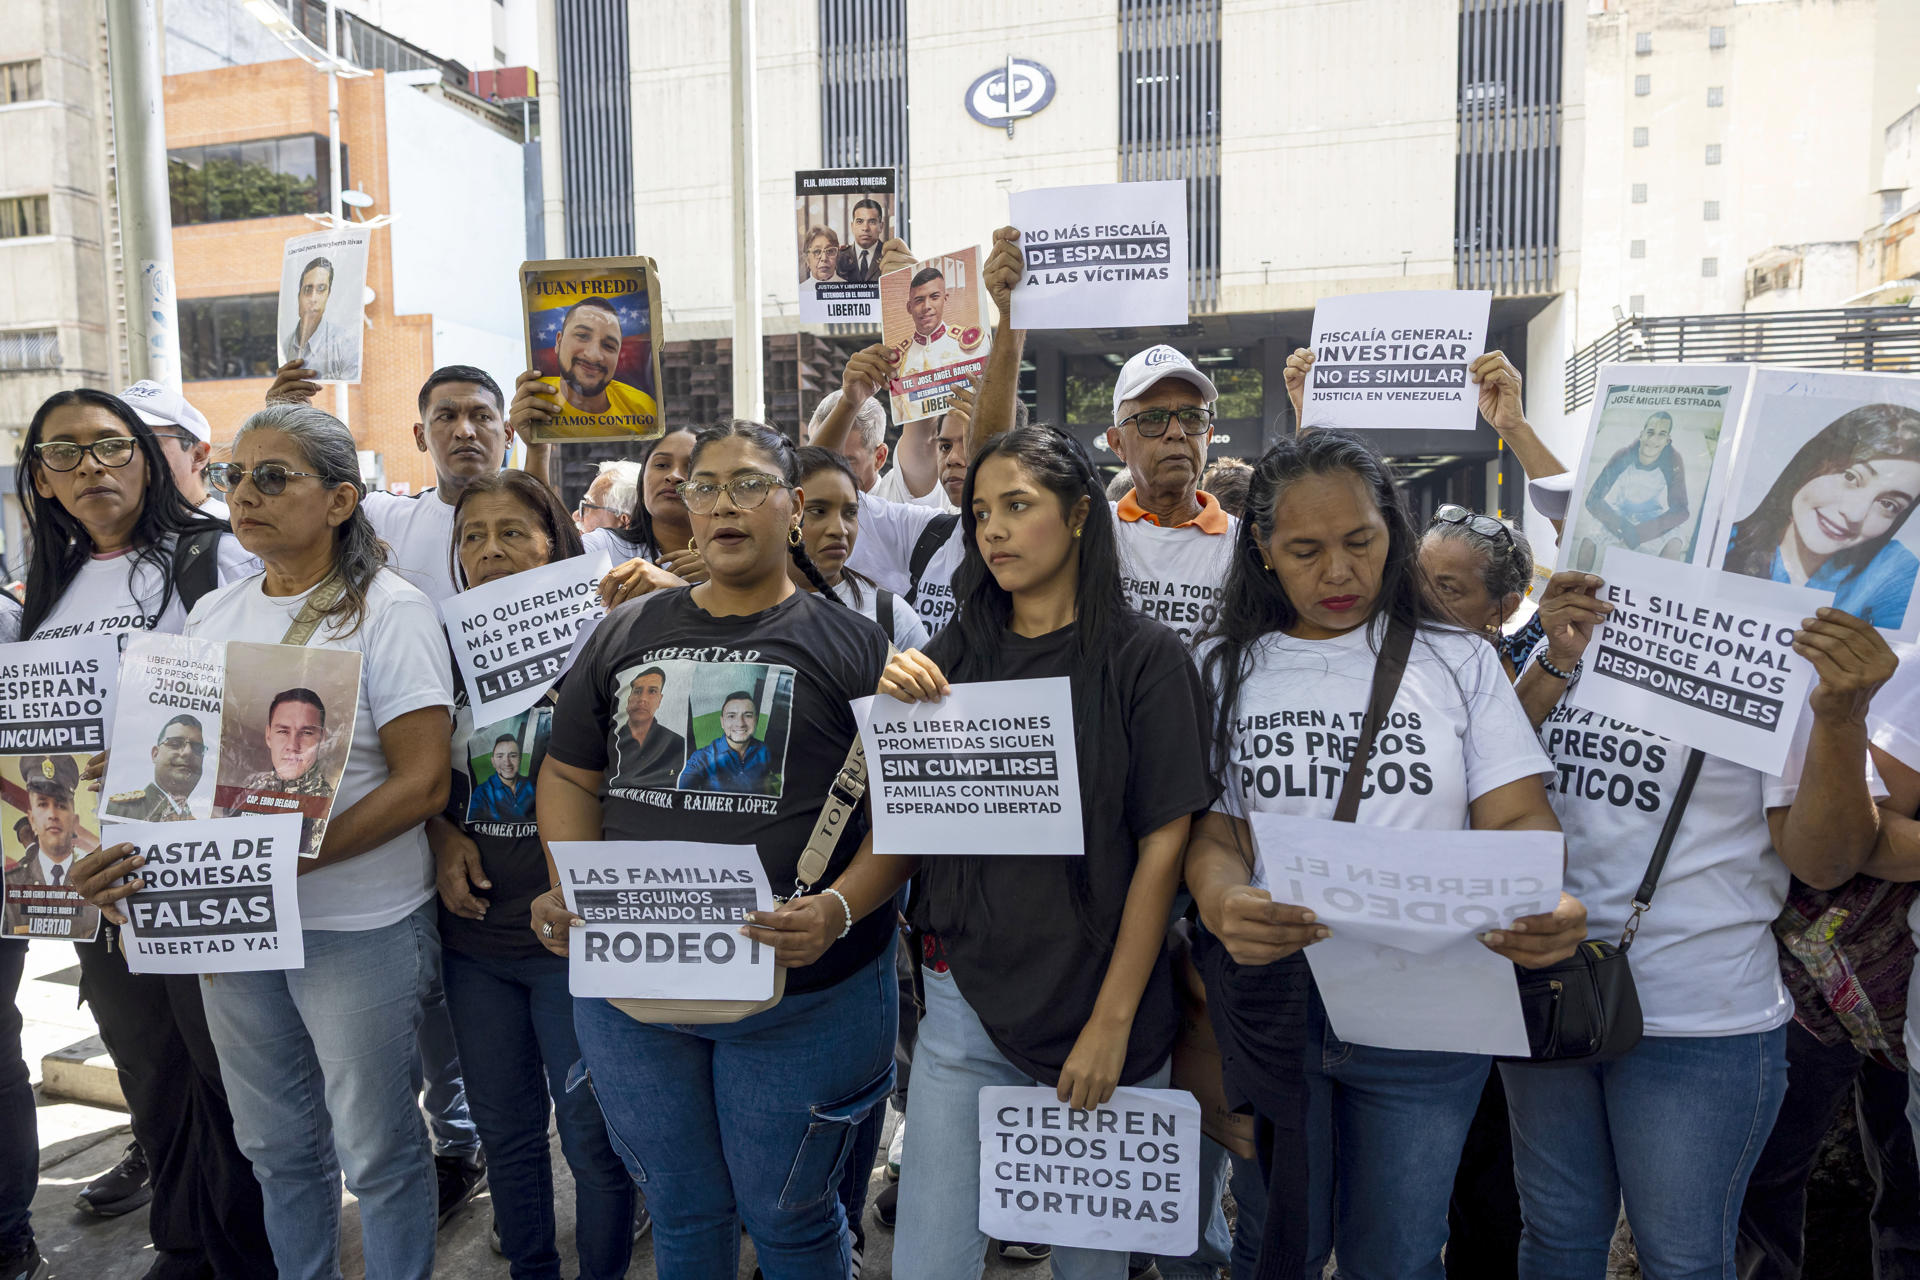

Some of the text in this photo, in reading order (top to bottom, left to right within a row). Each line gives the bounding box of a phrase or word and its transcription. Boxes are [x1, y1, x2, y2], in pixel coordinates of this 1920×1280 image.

[803, 176, 886, 188] FLIA. MONASTERIOS VANEGAS
[1025, 220, 1167, 243] NO MÁS FISCALÍA
[1028, 243, 1168, 266] DE ESPALDAS
[1026, 266, 1168, 286] A LAS VÍCTIMAS
[535, 280, 578, 296] JUAN
[828, 304, 870, 316] LIBERTAD
[1320, 328, 1472, 343] FISCALÍA GENERAL:
[1317, 344, 1466, 362] INVESTIGAR
[918, 375, 932, 386] JOSE
[934, 370, 952, 381] ANGEL
[1316, 369, 1464, 384] NO ES SIMULAR
[1312, 392, 1462, 401] JUSTICIA EN VENEZUELA
[1631, 385, 1704, 395] LIBERTAD PARA
[1636, 396, 1672, 406] MIGUEL
[1674, 398, 1721, 408] ESTRADA
[598, 415, 654, 425] CONTIGO
[1164, 582, 1174, 596] A
[461, 578, 600, 633] NO QUEREMOS
[84, 621, 95, 633] A
[100, 614, 158, 630] TODOS
[466, 595, 602, 650] MÁS PROMESAS
[1607, 586, 1795, 647] EL SILENCIO
[1606, 608, 1792, 672] INSTITUCIONAL
[146, 656, 188, 668] LIBERTAD
[191, 661, 215, 671] PARA
[642, 647, 760, 664] LIBERTAD
[1602, 626, 1786, 694] PROTEGE A LOS
[23, 659, 98, 677] FAMILIAS
[146, 666, 162, 675] LOS
[164, 669, 199, 680] PRESOS
[1598, 652, 1777, 724] RESPONSABLES
[23, 699, 102, 719] ESTADO
[1578, 711, 1594, 725] A
[873, 716, 1050, 734] LAS LIBERACIONES
[1237, 710, 1326, 734] LIBEREN
[1331, 714, 1345, 730] A
[1, 725, 100, 747] INCUMPLE
[878, 735, 1054, 750] PROMETIDAS SIGUEN
[1239, 732, 1294, 762] LOS
[1549, 728, 1667, 773] PRESOS
[883, 758, 1055, 777] SIN CUMPLIRSE
[1241, 757, 1433, 800] POLÍTCOS
[884, 785, 1059, 798] FAMILIAS CONTINUAN
[247, 795, 258, 805] CAP.
[274, 798, 300, 809] DELGADO
[684, 795, 777, 815] RAIMER LÓPEZ
[886, 803, 1062, 814] ESPERANDO LIBERTAD
[474, 823, 513, 837] RAIMER
[232, 837, 274, 859] DE
[569, 868, 753, 885] LAS FAMILIAS
[617, 892, 713, 904] SEGUIMOS
[133, 896, 271, 929] FALSAS
[583, 907, 695, 920] ESPERANDO
[701, 907, 725, 920] EN
[29, 918, 71, 935] LIBERTAD
[138, 937, 278, 955] LIBERTAD YA!
[585, 931, 736, 964] RODEO
[997, 1107, 1176, 1137] CIERREN
[996, 1132, 1180, 1164] TODOS LOS
[995, 1161, 1181, 1192] CENTROS DE
[995, 1188, 1179, 1223] TORTURAS
